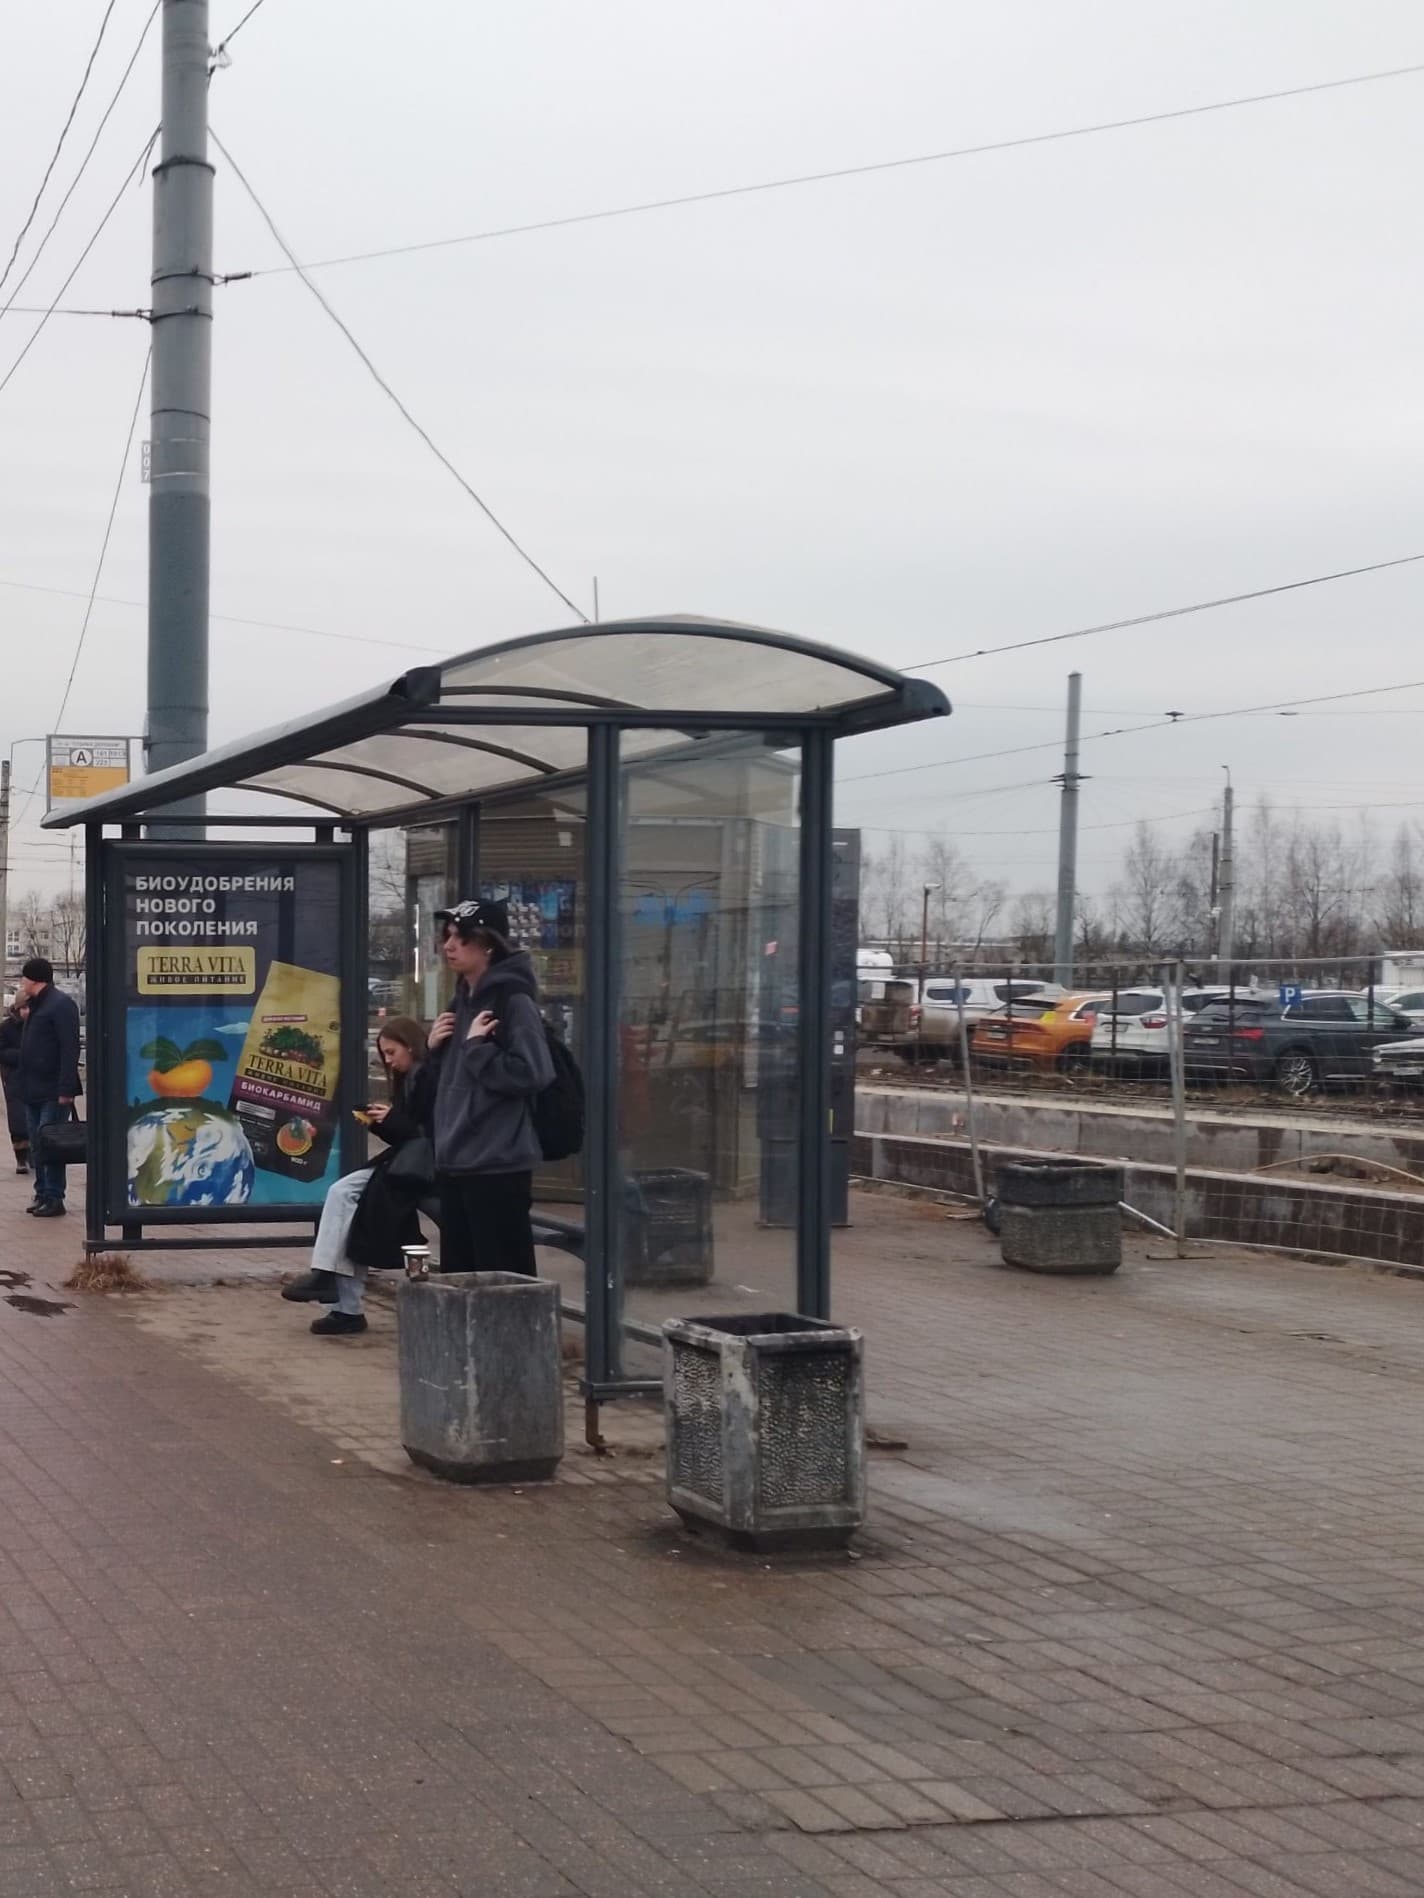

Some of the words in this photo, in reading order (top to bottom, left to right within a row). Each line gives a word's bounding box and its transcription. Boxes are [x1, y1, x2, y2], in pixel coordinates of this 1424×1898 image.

[76, 750, 88, 764] А
[135, 876, 295, 893] БИОУДОБРЕНИЯ
[136, 898, 216, 914] НОВОГО
[136, 920, 258, 936] ПОКОЛЕНИЯ
[147, 956, 204, 973] TERRA
[207, 956, 245, 973] VITA
[149, 975, 188, 984] ЖИВОЕ
[194, 976, 245, 984] ПИТАНИЕ
[1285, 987, 1296, 1003] P
[248, 1054, 294, 1077] TERRA
[297, 1066, 327, 1087] VITA
[240, 1081, 321, 1111] БИОКАРБАМИД
